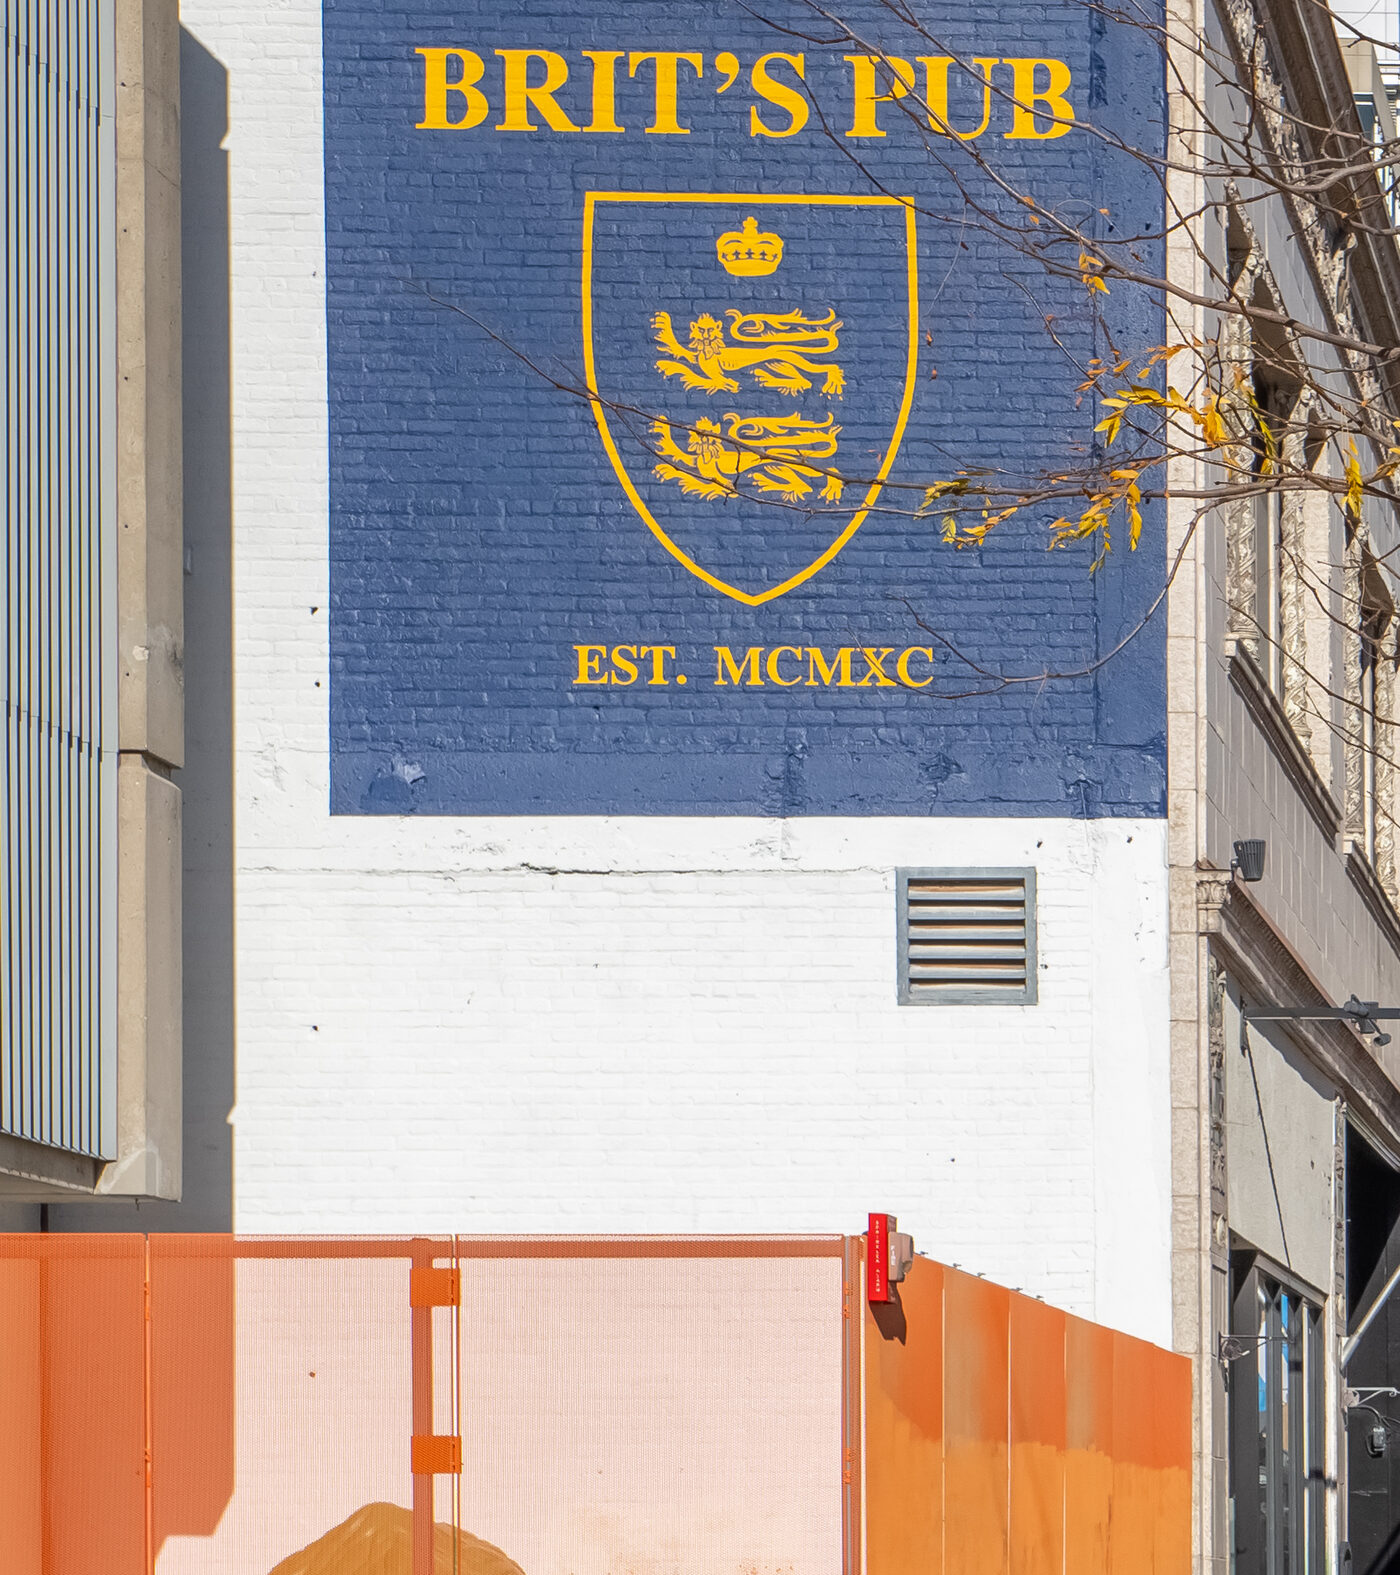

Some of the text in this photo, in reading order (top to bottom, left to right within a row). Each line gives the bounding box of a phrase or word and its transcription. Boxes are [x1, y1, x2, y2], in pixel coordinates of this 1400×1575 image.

[415, 47, 1075, 141] BRIT'S PUB
[573, 645, 935, 689] EST. MCMXC
